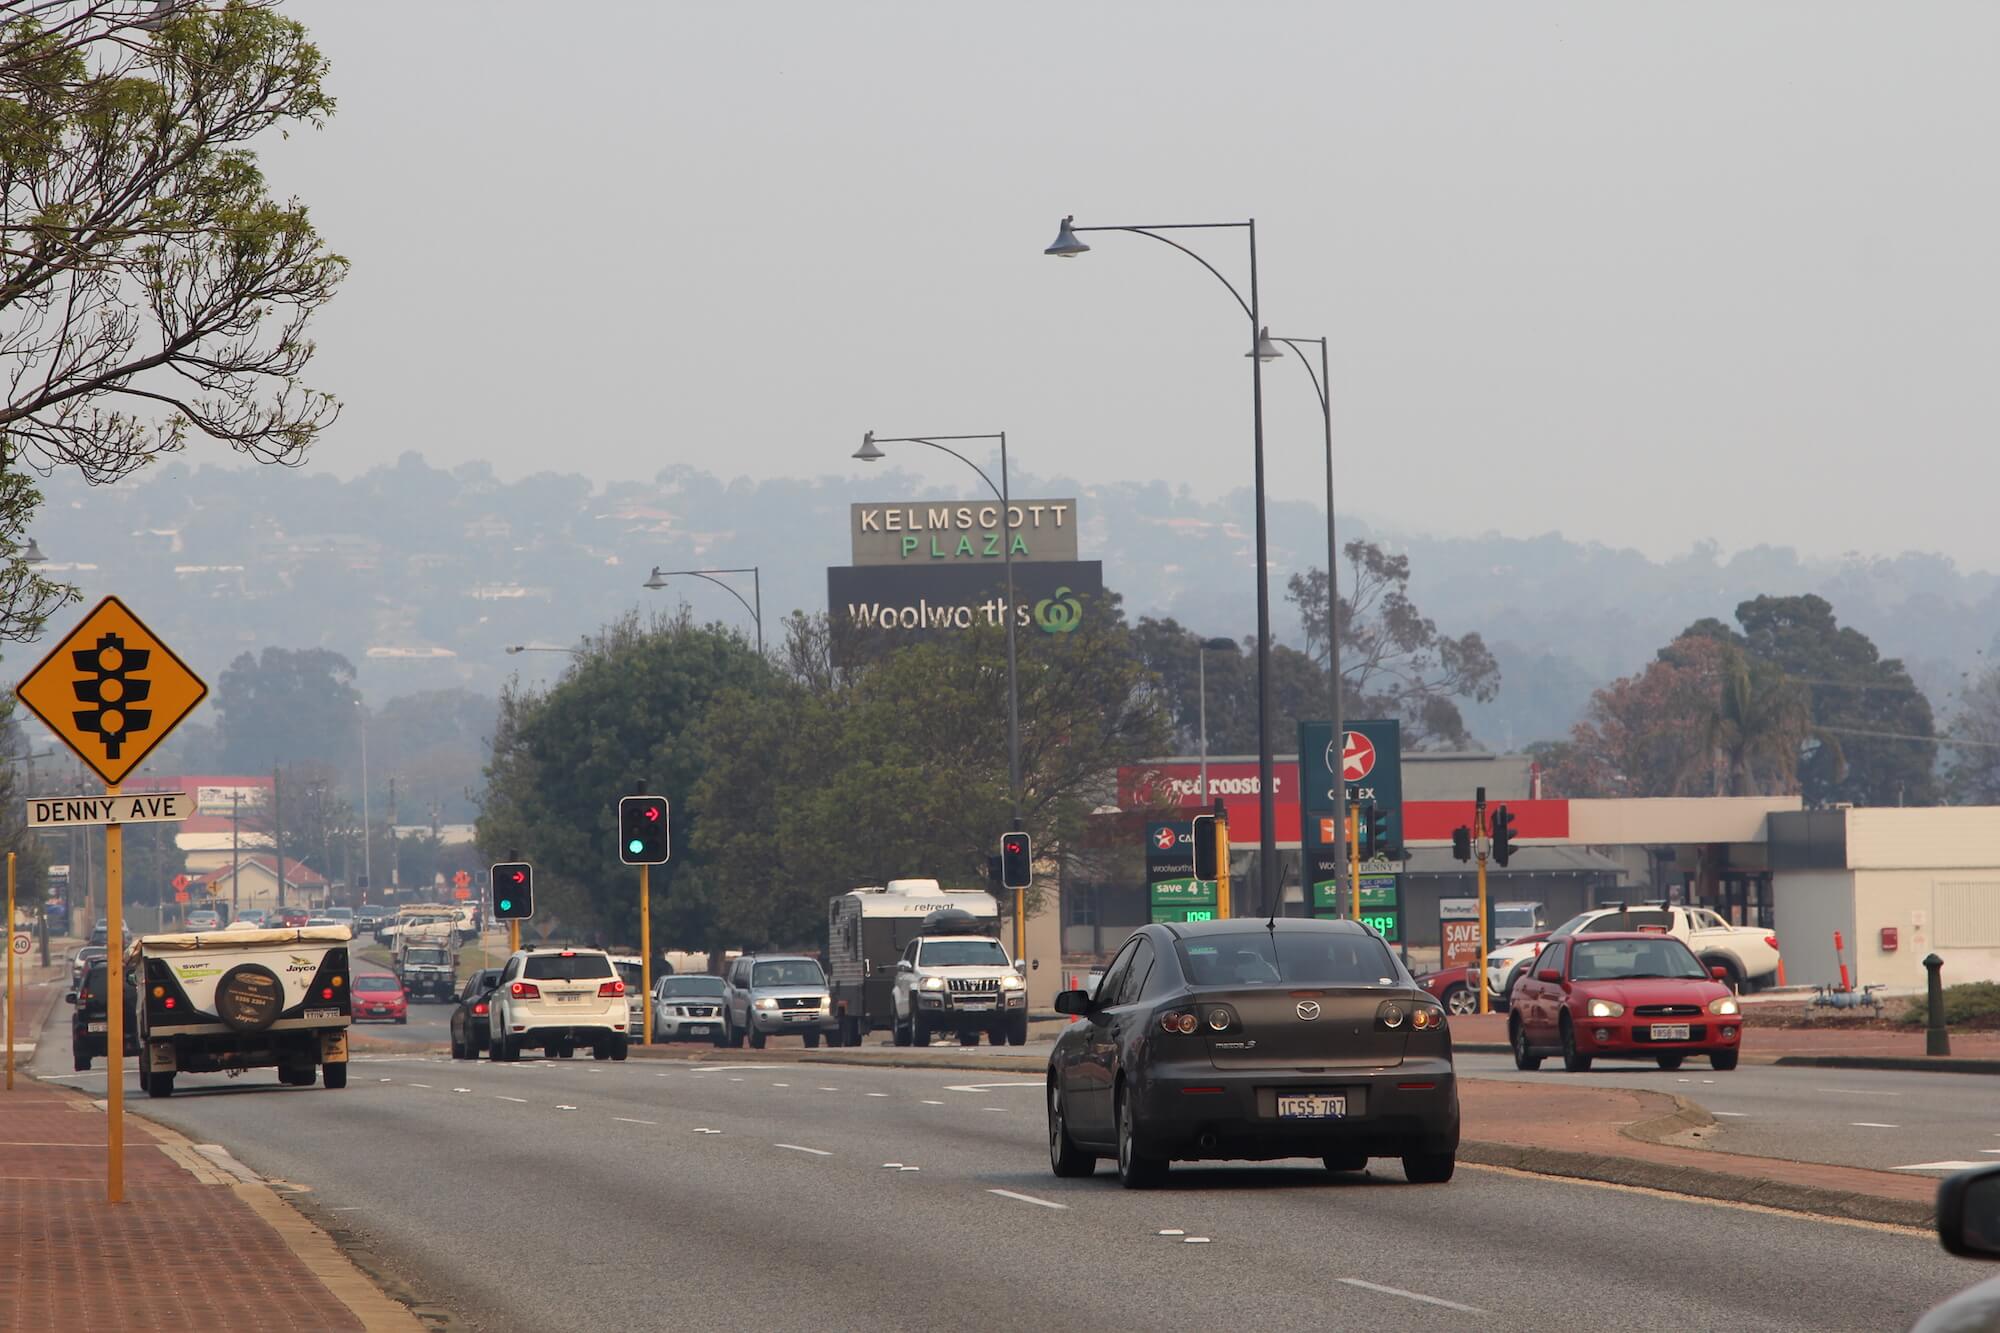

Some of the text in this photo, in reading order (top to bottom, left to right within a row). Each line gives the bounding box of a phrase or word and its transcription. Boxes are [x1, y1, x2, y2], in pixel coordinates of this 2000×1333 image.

[860, 505, 1068, 531] KELMSCOTT
[901, 533, 1030, 558] PLAZA
[1208, 776, 1281, 795] roostr
[1327, 787, 1376, 801] CLEX
[36, 799, 115, 822] DENNY
[130, 797, 177, 818] AVE
[1360, 863, 1393, 872] DENNY
[1156, 884, 1183, 893] save
[1187, 881, 1198, 895] 4
[914, 903, 955, 912] retreat
[1446, 925, 1480, 942] SAVE
[15, 940, 27, 949] 60
[285, 964, 317, 973] Jayco
